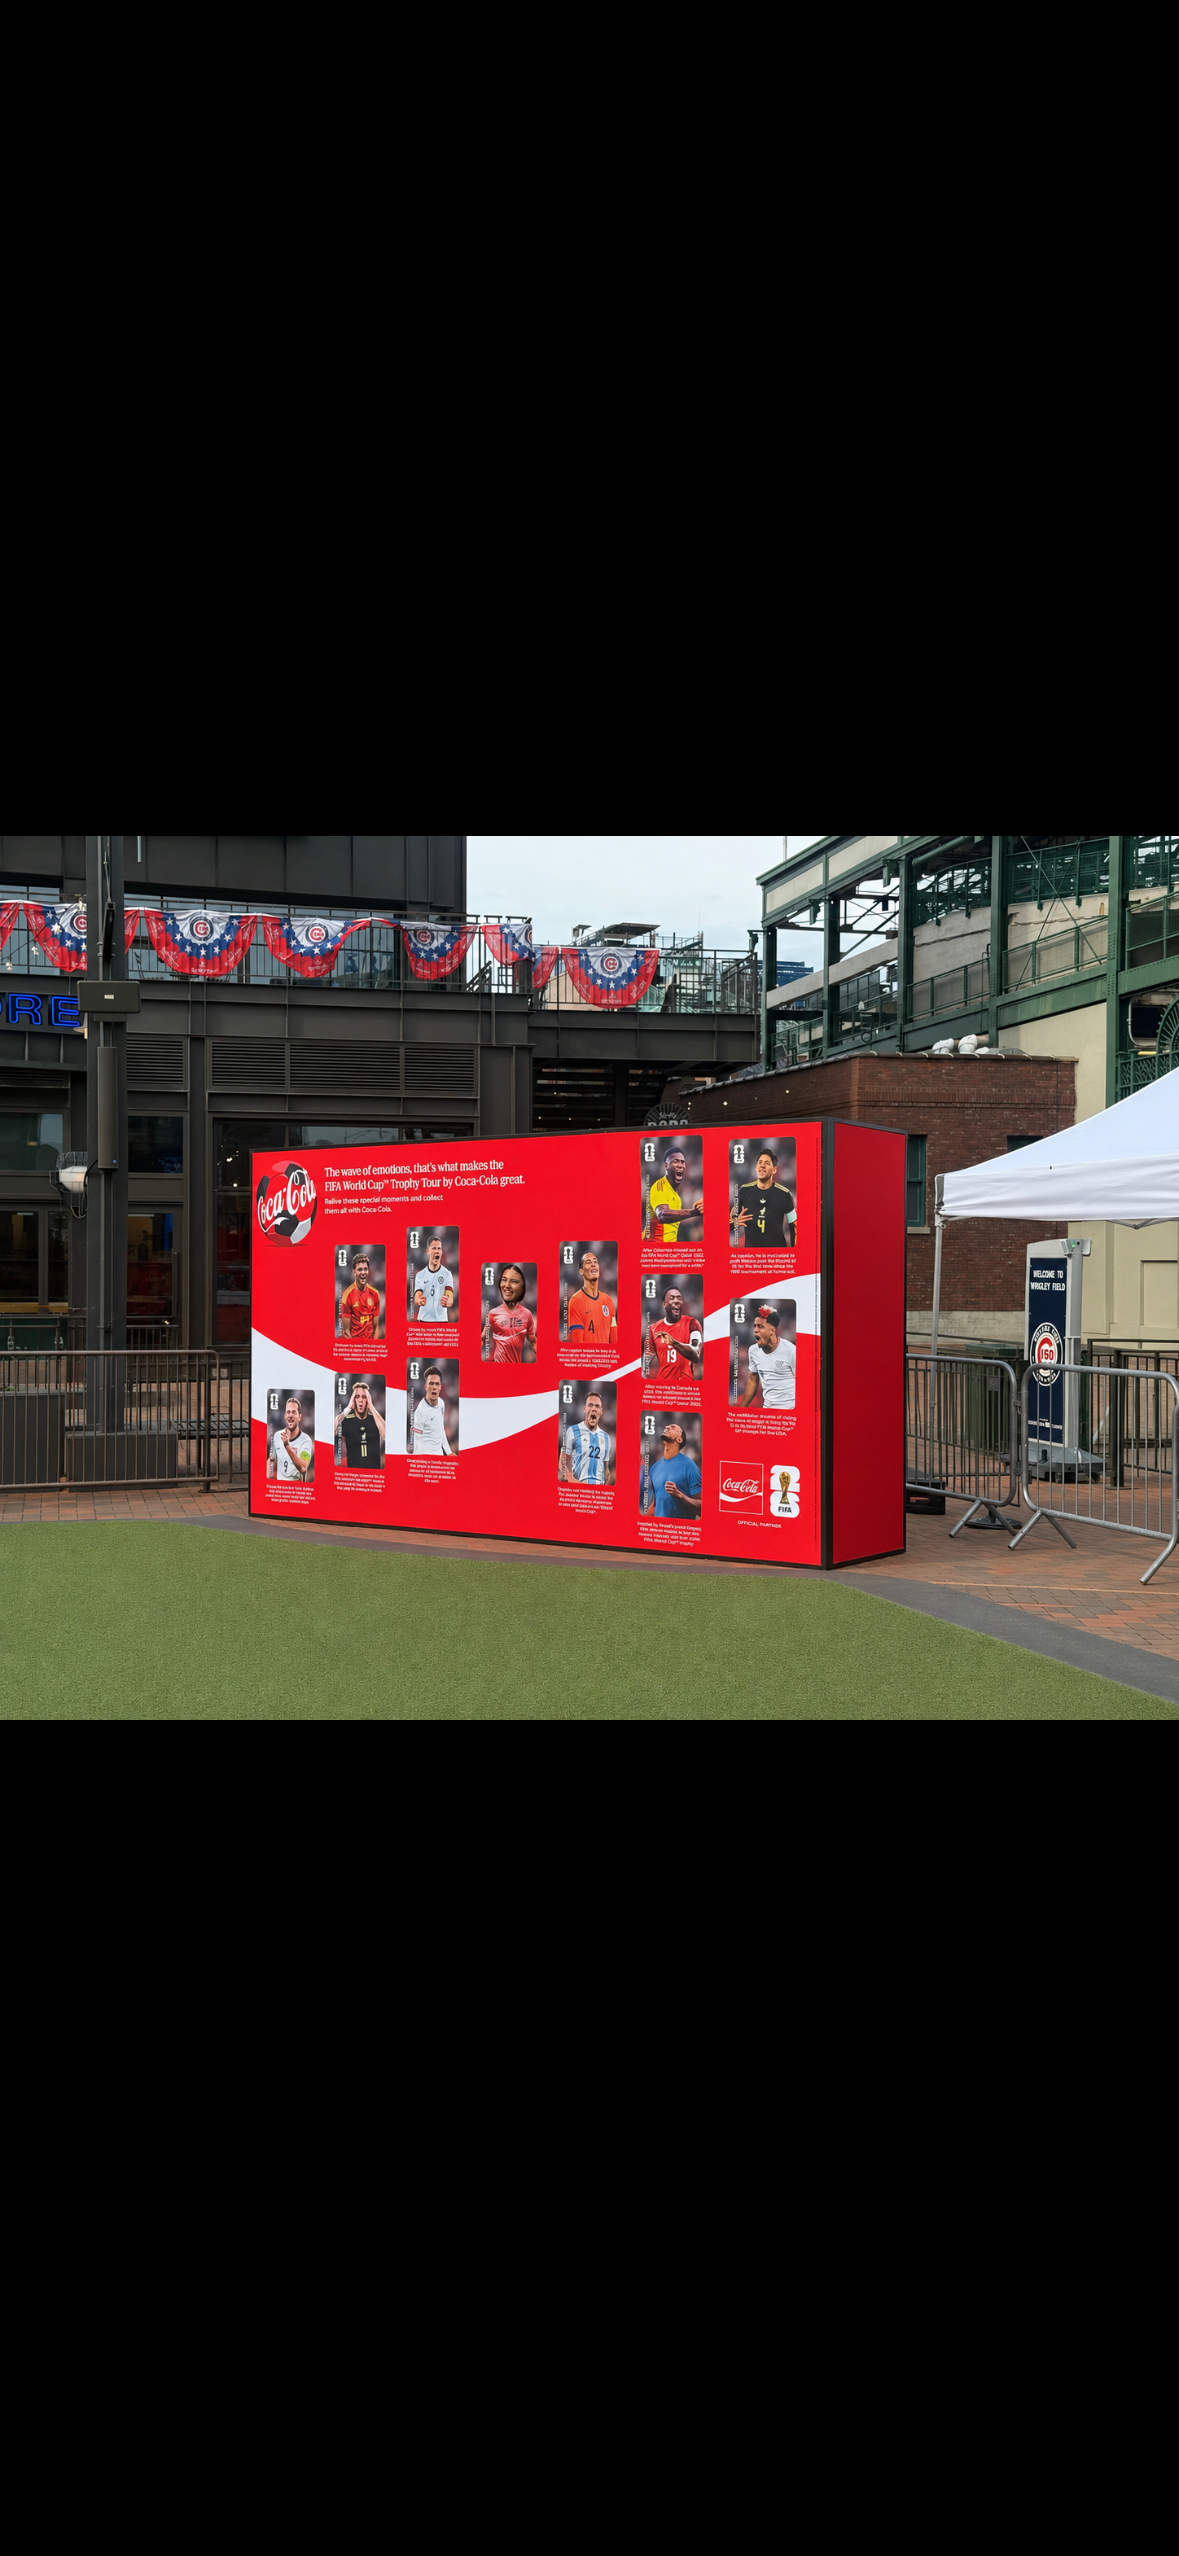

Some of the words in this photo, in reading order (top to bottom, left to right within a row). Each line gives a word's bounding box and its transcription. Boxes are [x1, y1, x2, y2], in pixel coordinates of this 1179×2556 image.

[0, 992, 80, 1027] RE
[324, 1167, 340, 1177] The
[341, 1167, 361, 1177] wave
[362, 1165, 372, 1176] of
[372, 1164, 412, 1175] emotions,
[438, 1161, 458, 1172] what
[460, 1160, 488, 1171] makes
[489, 1159, 504, 1170] the
[324, 1181, 341, 1192] FIFA
[343, 1179, 366, 1191] World
[390, 1177, 420, 1191] Trophy
[421, 1177, 441, 1188] Tour
[442, 1176, 453, 1189] by
[455, 1174, 499, 1187] Coca-Cola
[500, 1174, 525, 1187] great.
[359, 1196, 380, 1204] special
[381, 1195, 409, 1203] moments
[410, 1194, 422, 1202] and
[757, 1219, 765, 1234] 4
[1033, 1270, 1055, 1279] WELCOME
[1057, 1270, 1064, 1279] TO
[1030, 1282, 1051, 1291] WRIGLEY
[1052, 1282, 1066, 1291] FIELD
[667, 1349, 677, 1363] 19
[1041, 1348, 1054, 1361] 150
[588, 1445, 601, 1459] 22
[723, 1477, 760, 1494] Coca-Cola
[778, 1505, 792, 1513] FIFA
